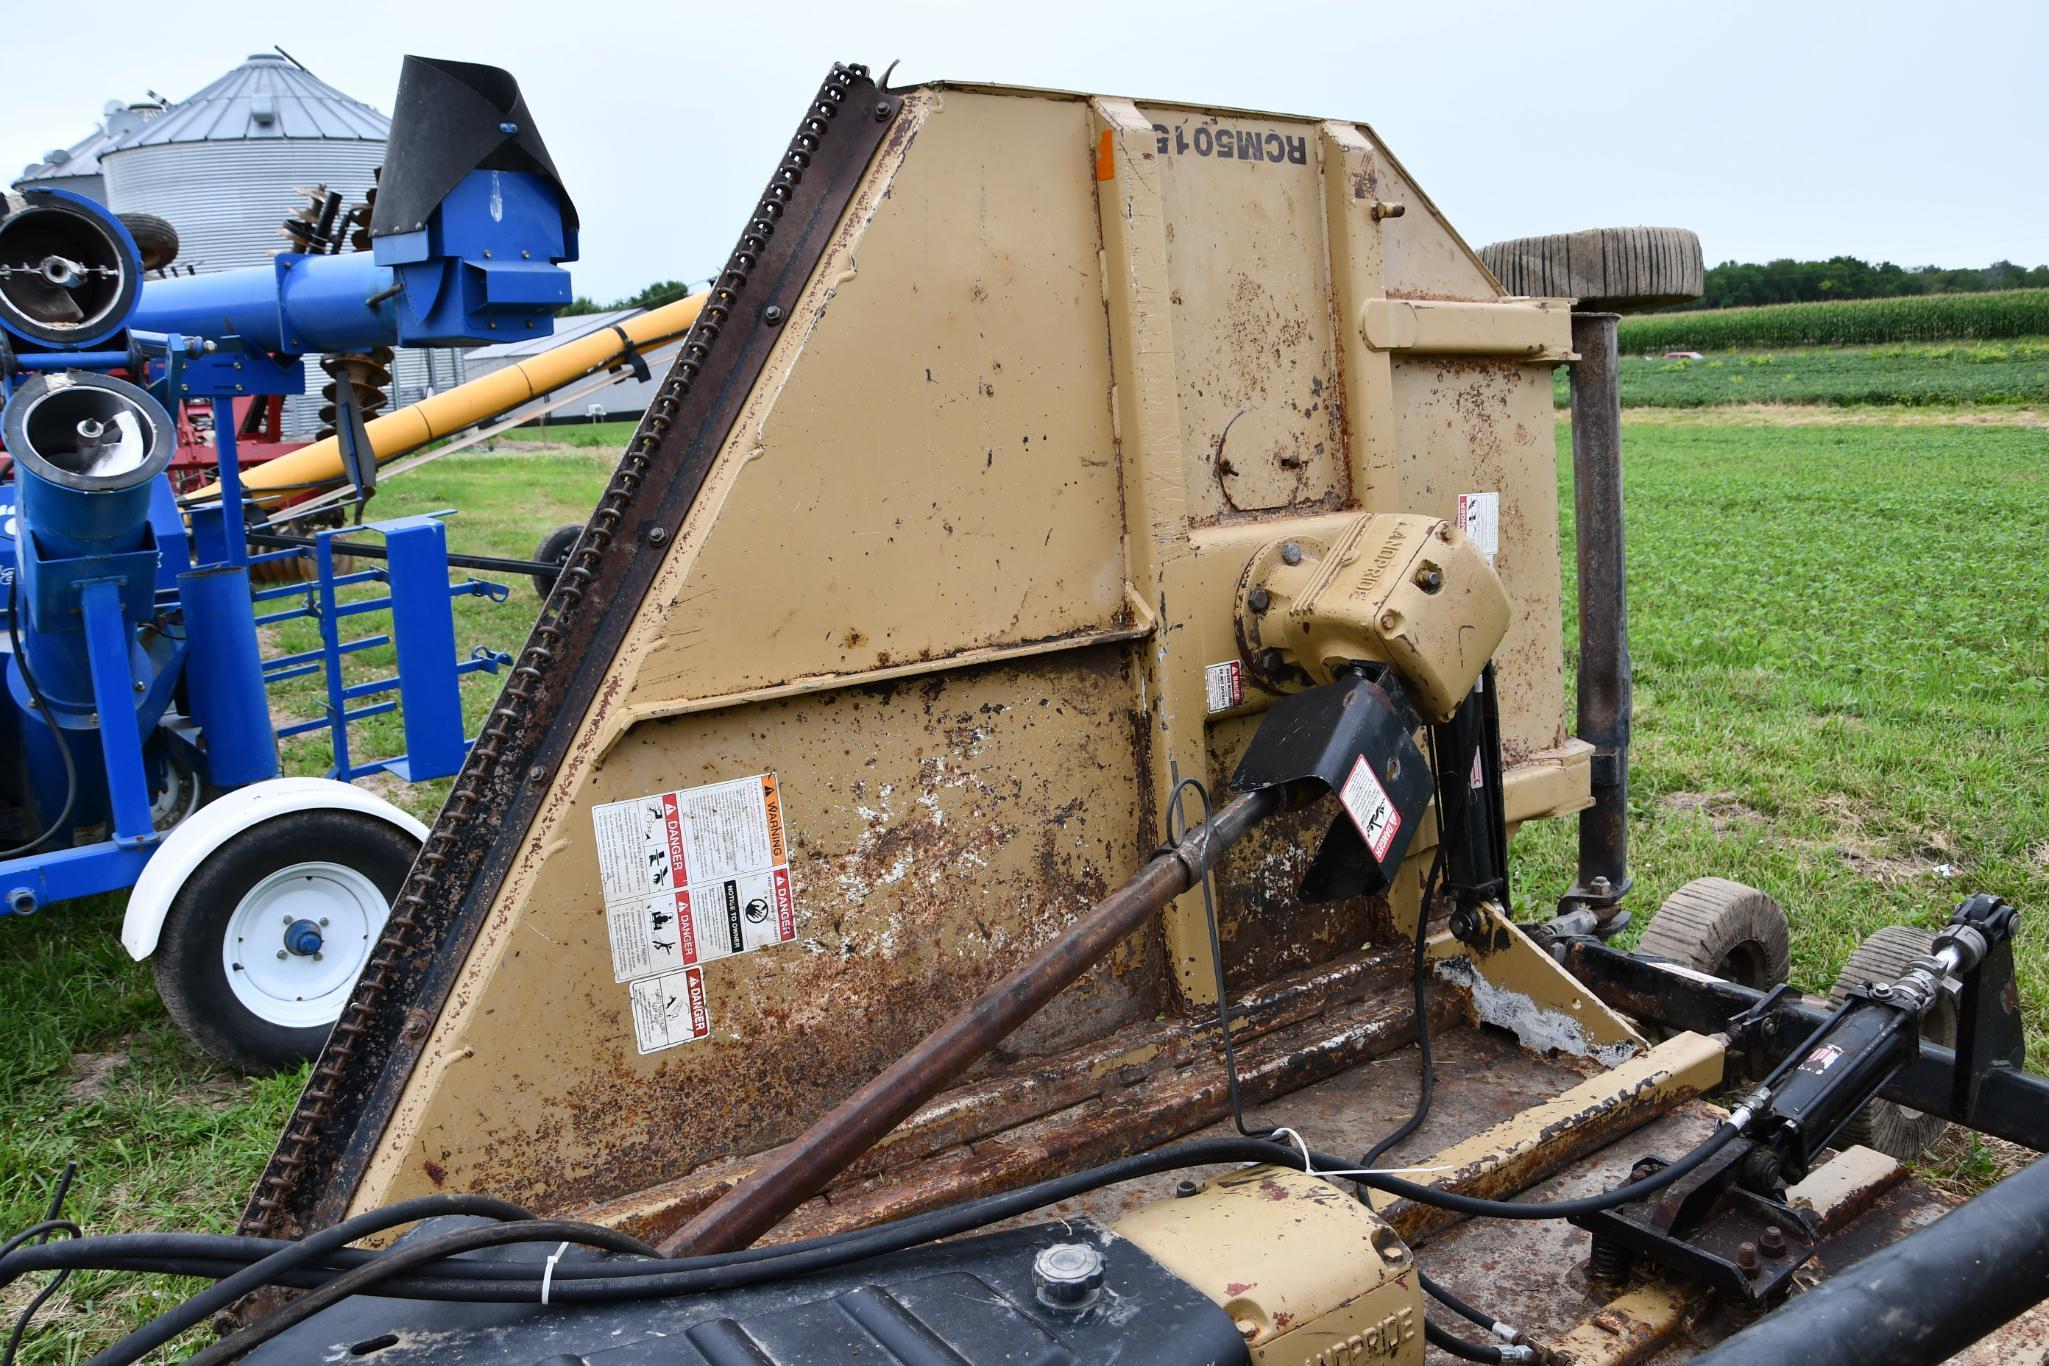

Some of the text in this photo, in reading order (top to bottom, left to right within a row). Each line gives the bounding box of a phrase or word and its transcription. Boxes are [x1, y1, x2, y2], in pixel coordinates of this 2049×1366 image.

[666, 819, 683, 871] DANGER
[766, 801, 782, 857] WARNING
[1375, 824, 1393, 858] DANGER
[679, 914, 694, 956] DANGER
[726, 884, 741, 949] NOTICE TO OWNER
[776, 887, 791, 935] DANGER
[690, 986, 705, 1031] DANGER
